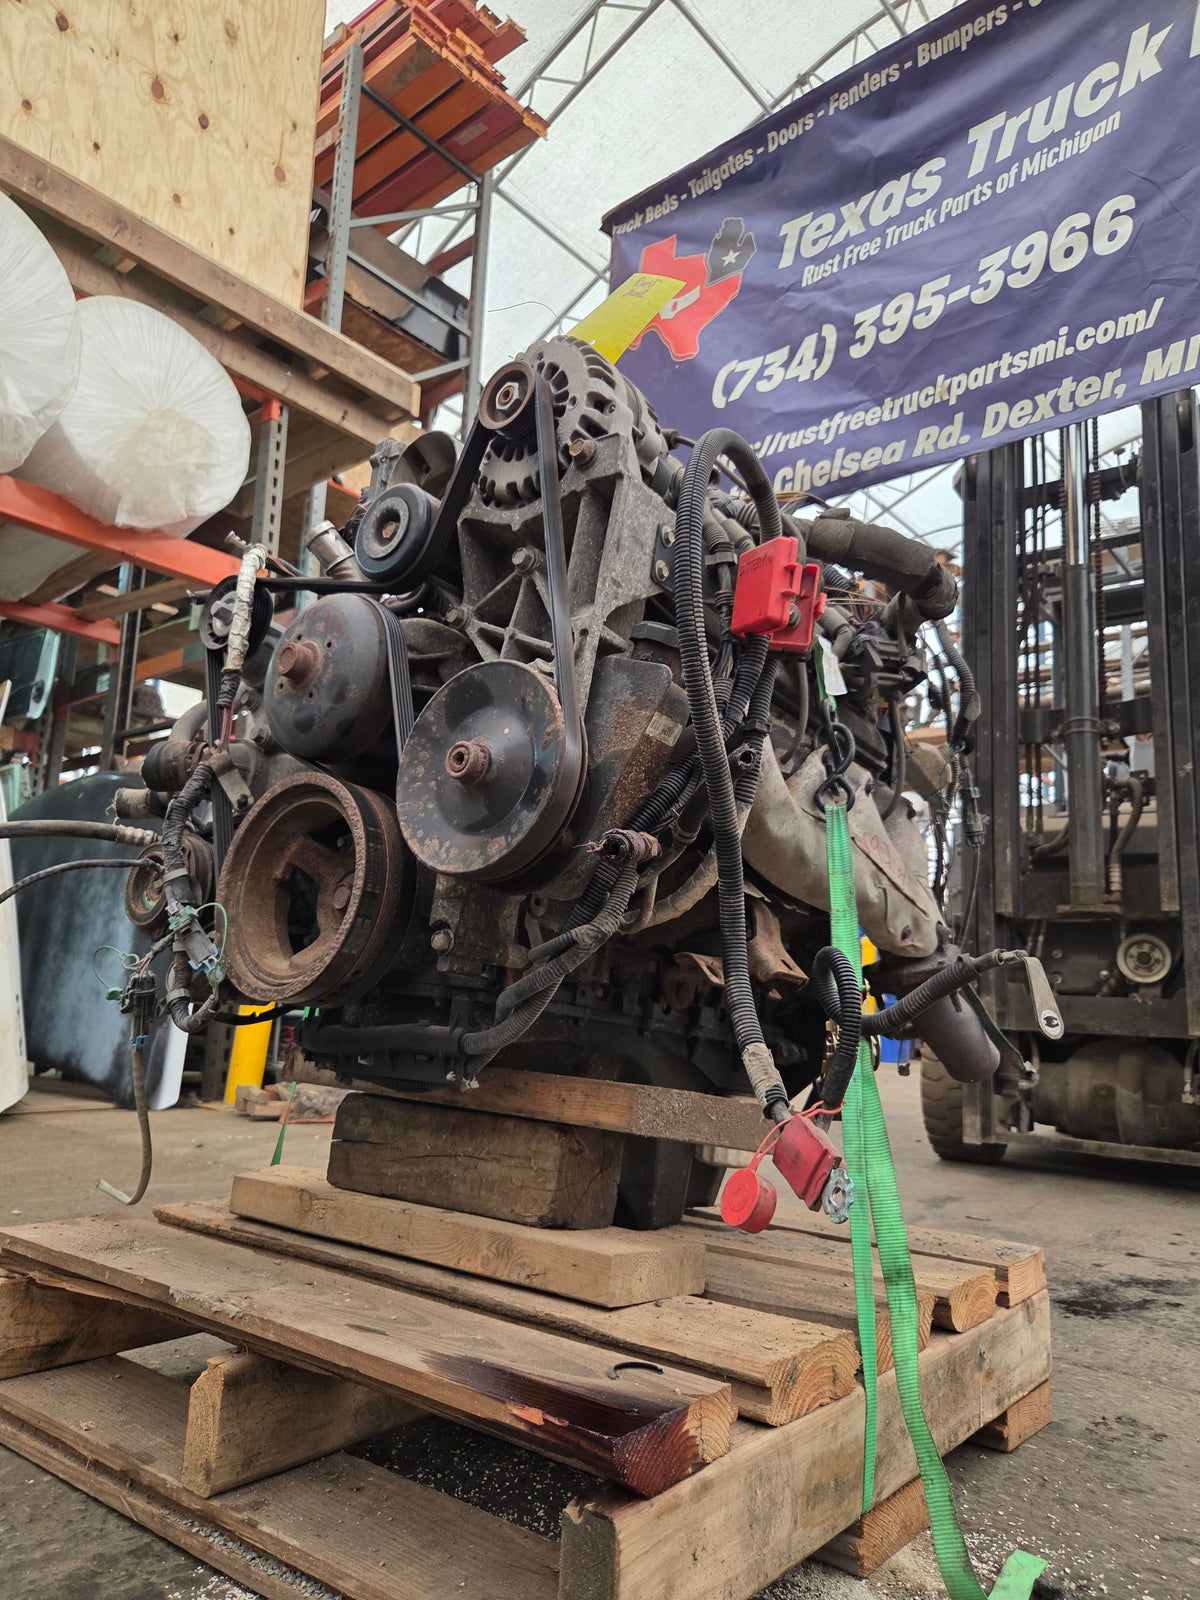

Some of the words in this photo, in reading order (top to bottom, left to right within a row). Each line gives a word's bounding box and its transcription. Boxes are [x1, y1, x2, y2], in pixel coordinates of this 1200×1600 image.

[612, 211, 644, 238] ruck
[645, 193, 679, 224] Beds
[688, 148, 754, 199] Tailgates
[767, 112, 814, 153] Doors
[828, 63, 900, 116] Fenders
[917, 4, 1008, 68] Bumpers
[778, 157, 946, 270] Texas
[967, 22, 1174, 179] Truck
[802, 253, 841, 288] Rust
[842, 236, 881, 269] Free
[885, 208, 938, 249] Truck
[940, 180, 993, 224] Parts
[996, 162, 1019, 194] of
[1020, 111, 1121, 182] Michigan
[711, 323, 837, 409] (734)
[848, 194, 1136, 359] 395-3966
[750, 298, 1164, 459] ://rustfreetruckpartsmi.com/
[773, 439, 906, 492] Chelsea
[911, 411, 970, 460] Rd.
[981, 368, 1127, 439] Dexter,
